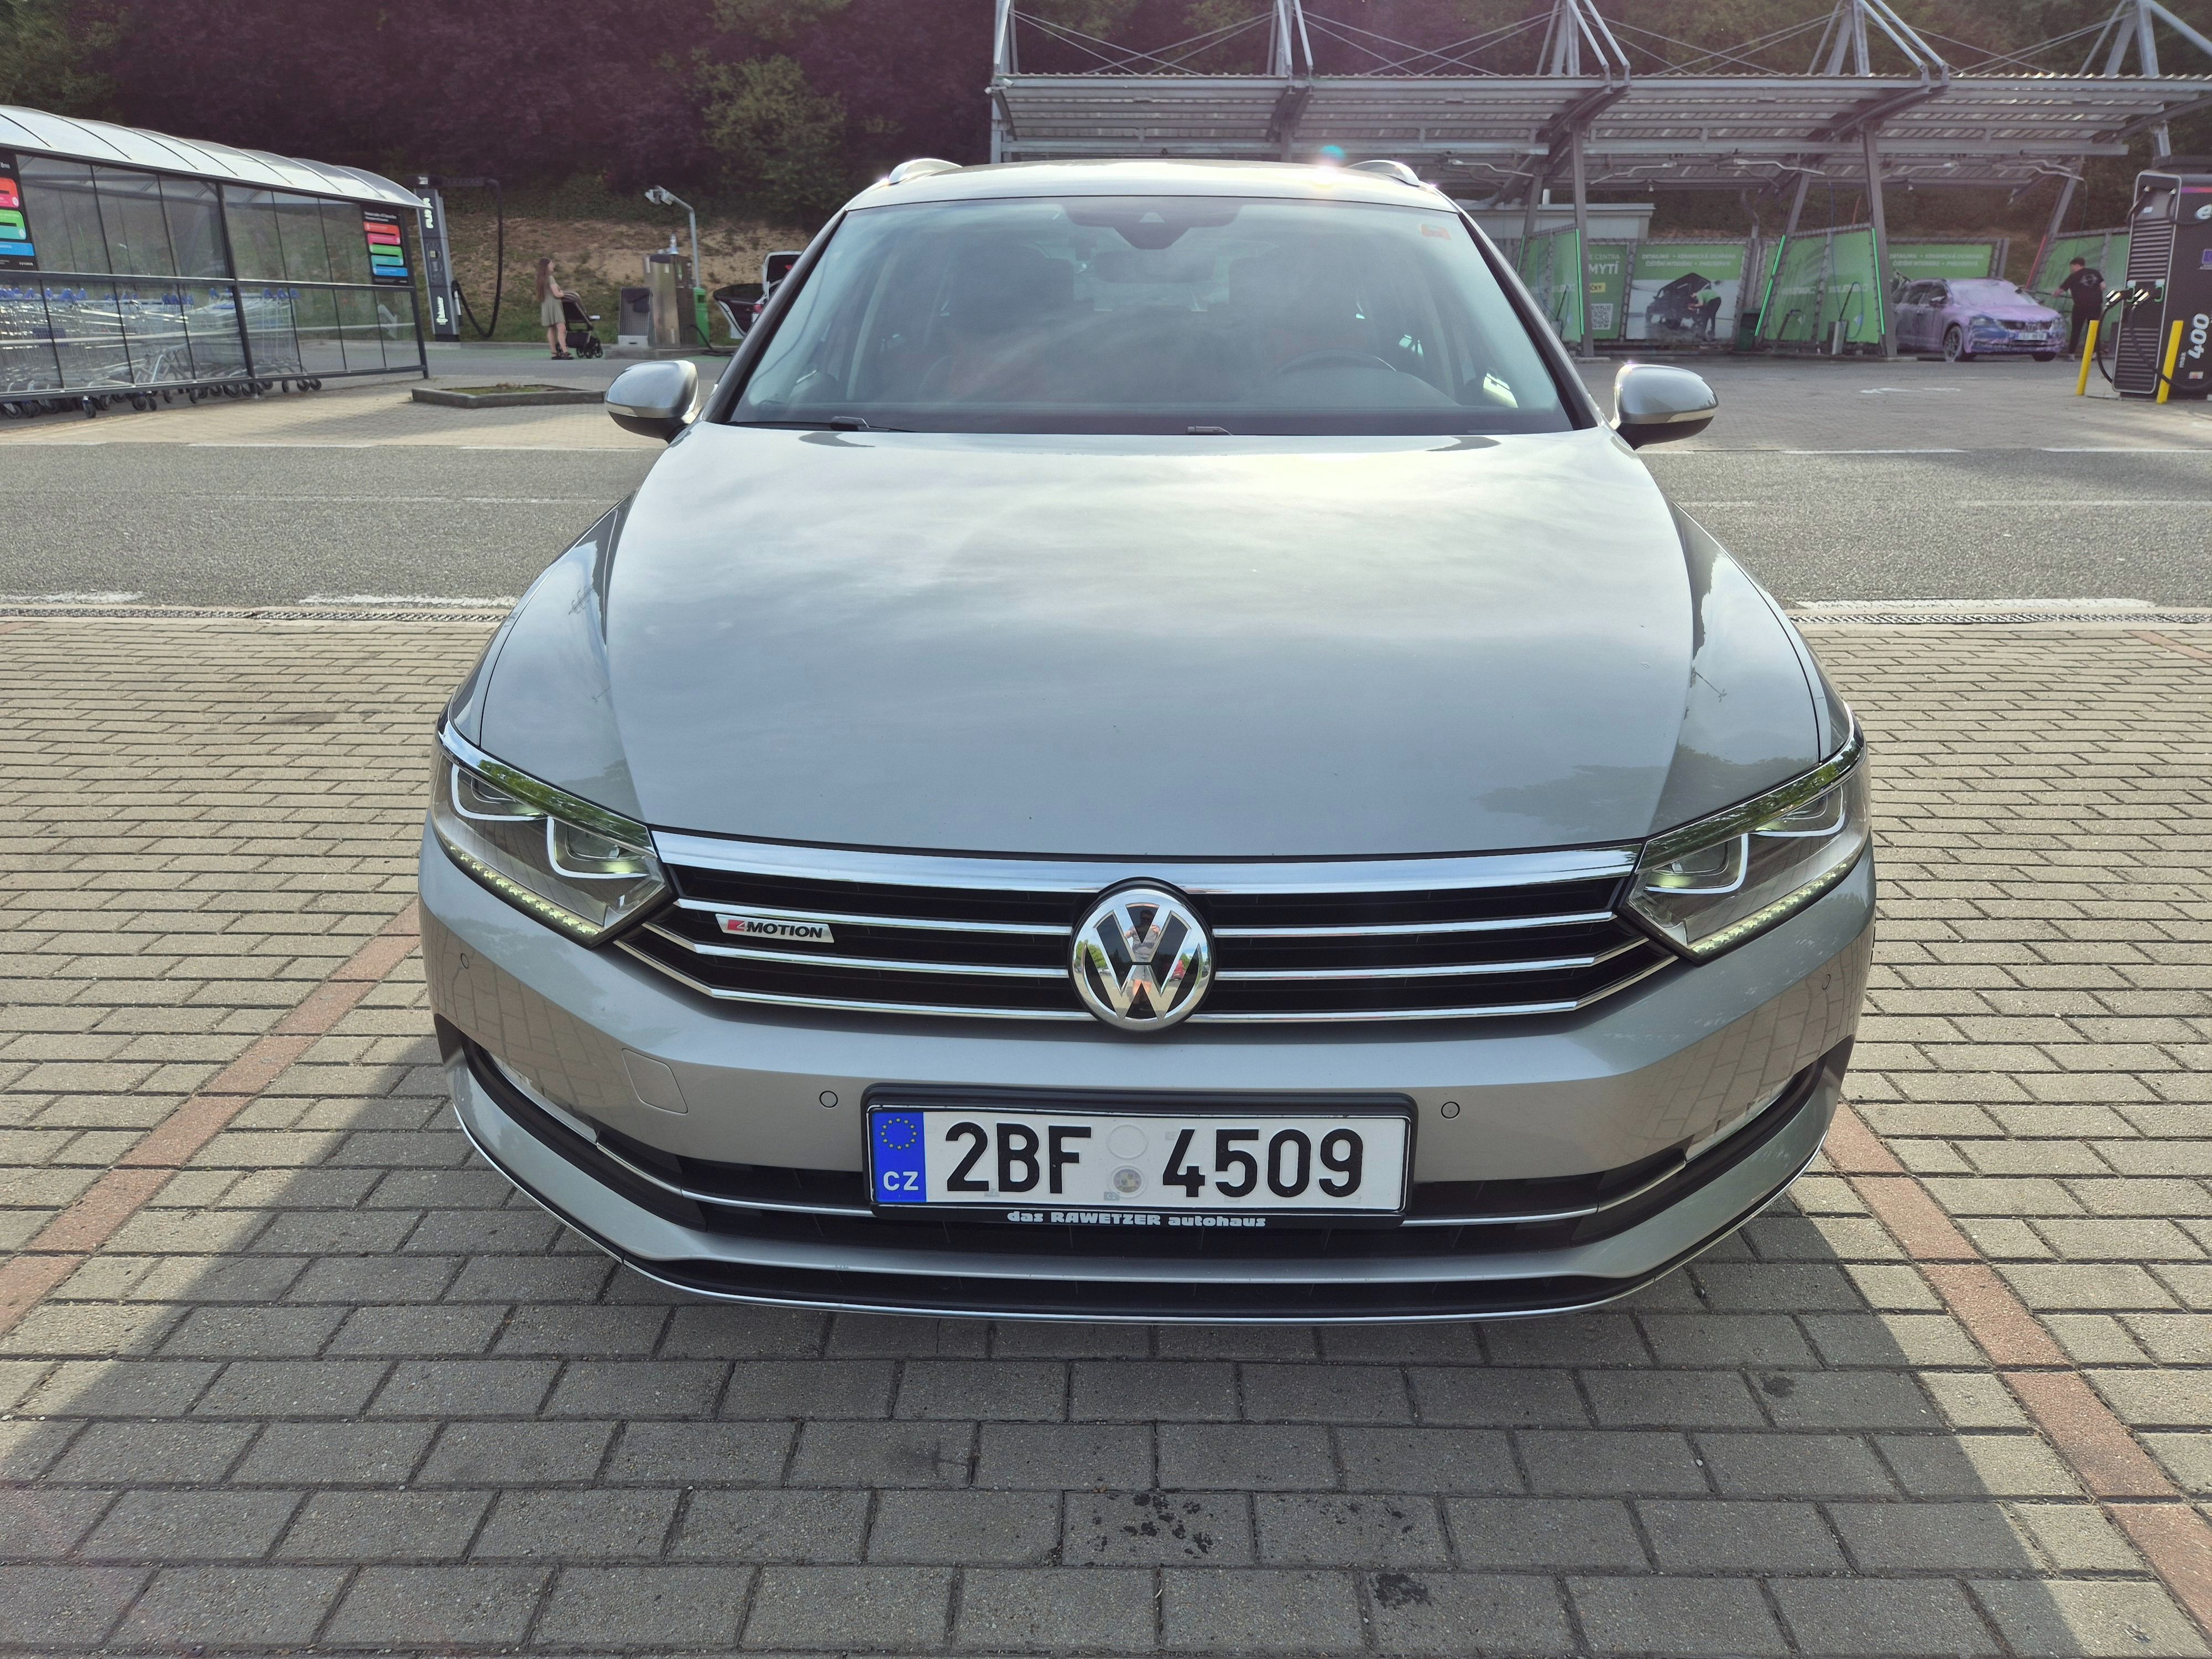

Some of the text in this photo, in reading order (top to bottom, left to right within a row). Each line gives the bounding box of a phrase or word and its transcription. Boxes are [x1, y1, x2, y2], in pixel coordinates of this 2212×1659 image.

[1588, 260, 1619, 275] MYTÍ
[2188, 313, 2209, 359] 400
[945, 1121, 1363, 1198] 2BF 4509
[883, 1171, 919, 1191] CZ
[1007, 1211, 1266, 1227] das RAWETZER autohaus
